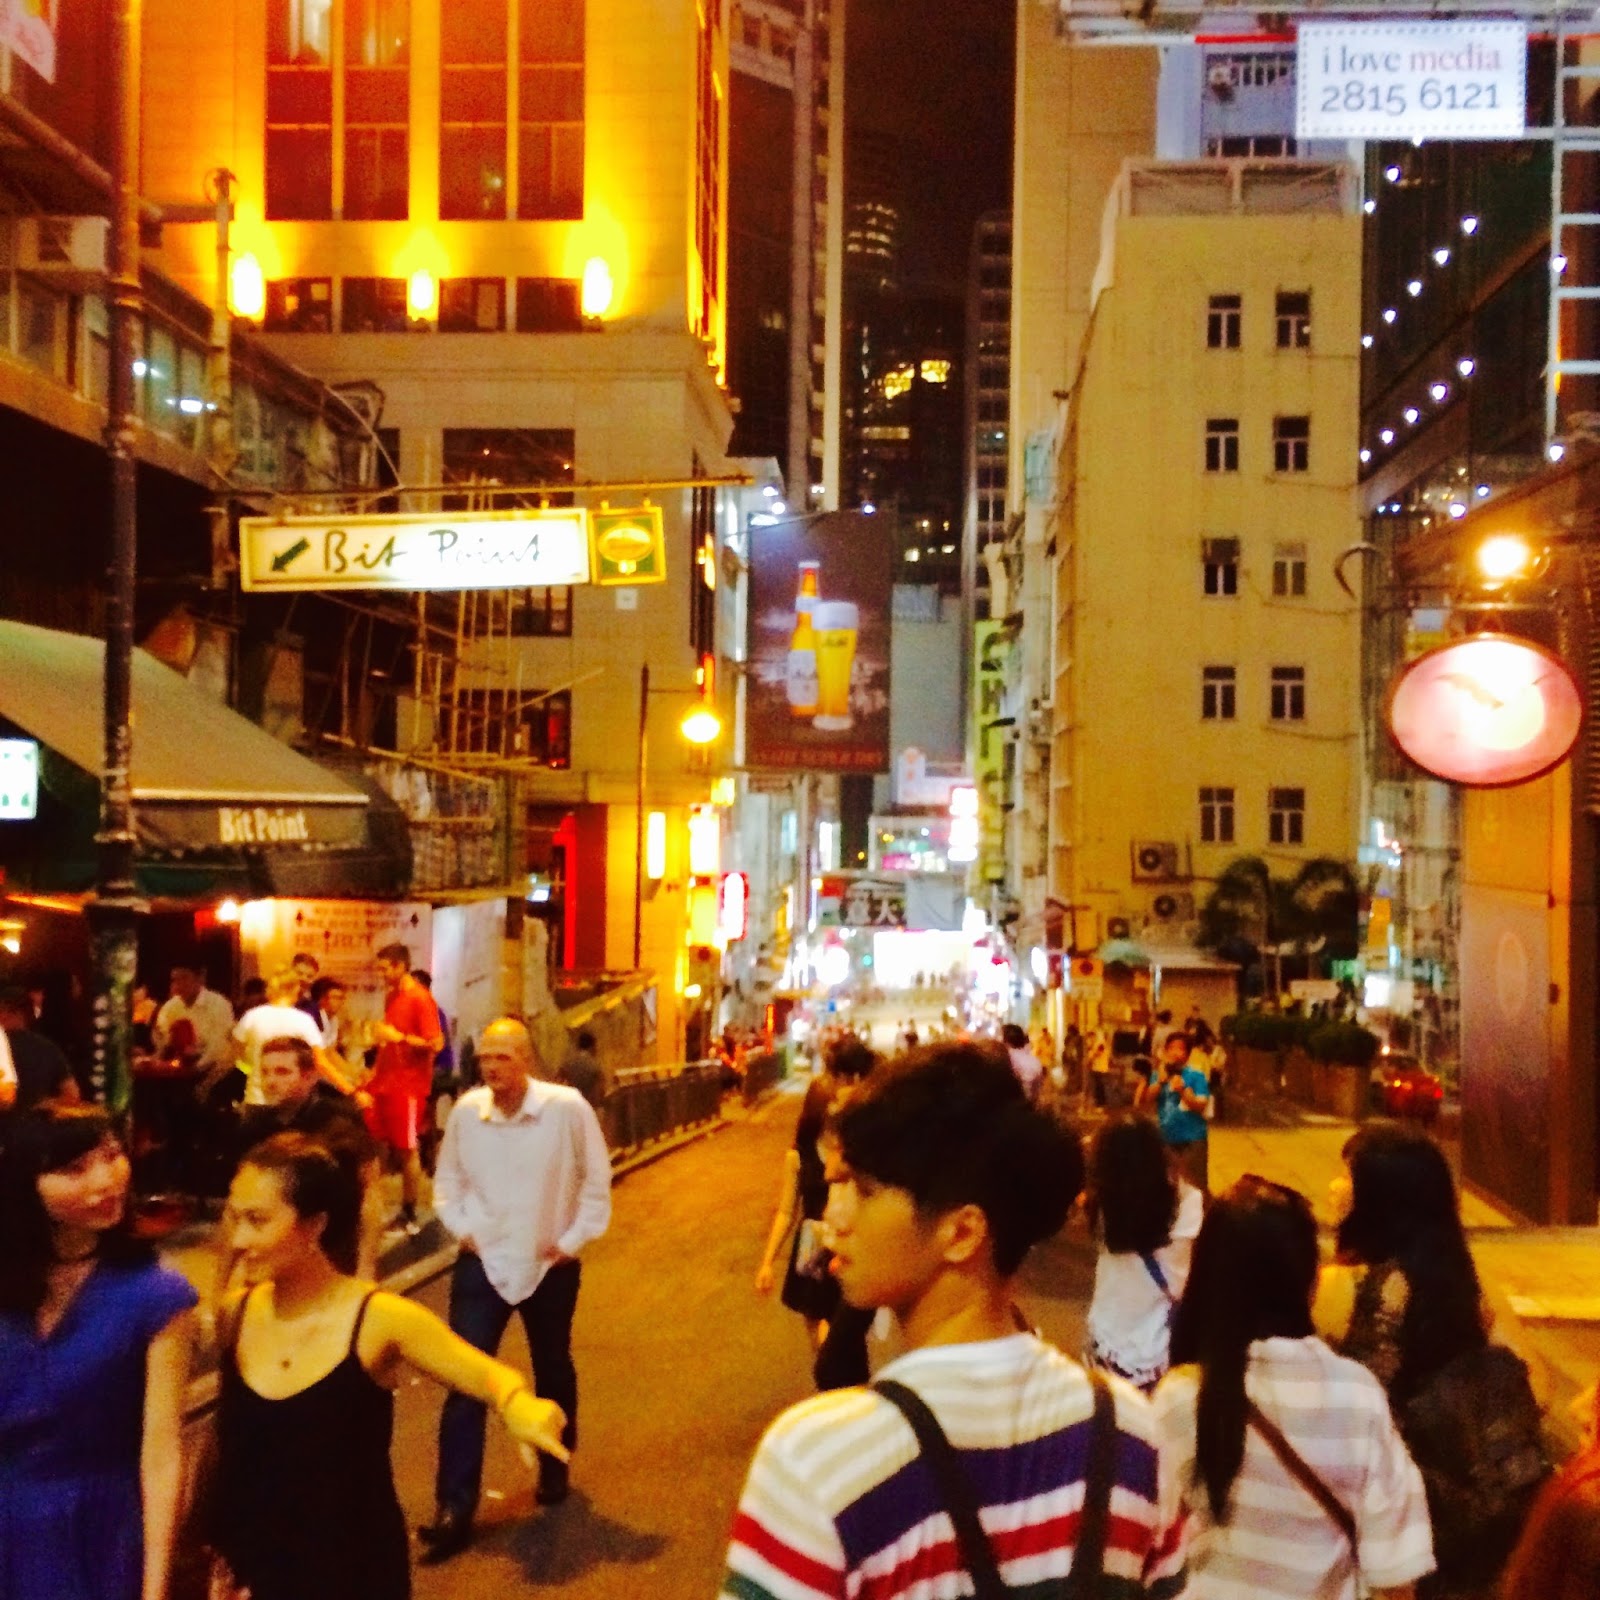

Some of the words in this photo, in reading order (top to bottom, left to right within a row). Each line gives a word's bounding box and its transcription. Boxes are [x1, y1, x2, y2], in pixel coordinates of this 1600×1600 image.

[1323, 46, 1331, 74] i
[1340, 45, 1401, 73] love
[1410, 42, 1503, 72] media
[1321, 79, 1407, 116] 2815
[1419, 77, 1500, 111] 6121
[322, 529, 408, 573] Bit
[427, 527, 542, 567] Point
[219, 806, 254, 842] Bit
[254, 806, 308, 842] Point
